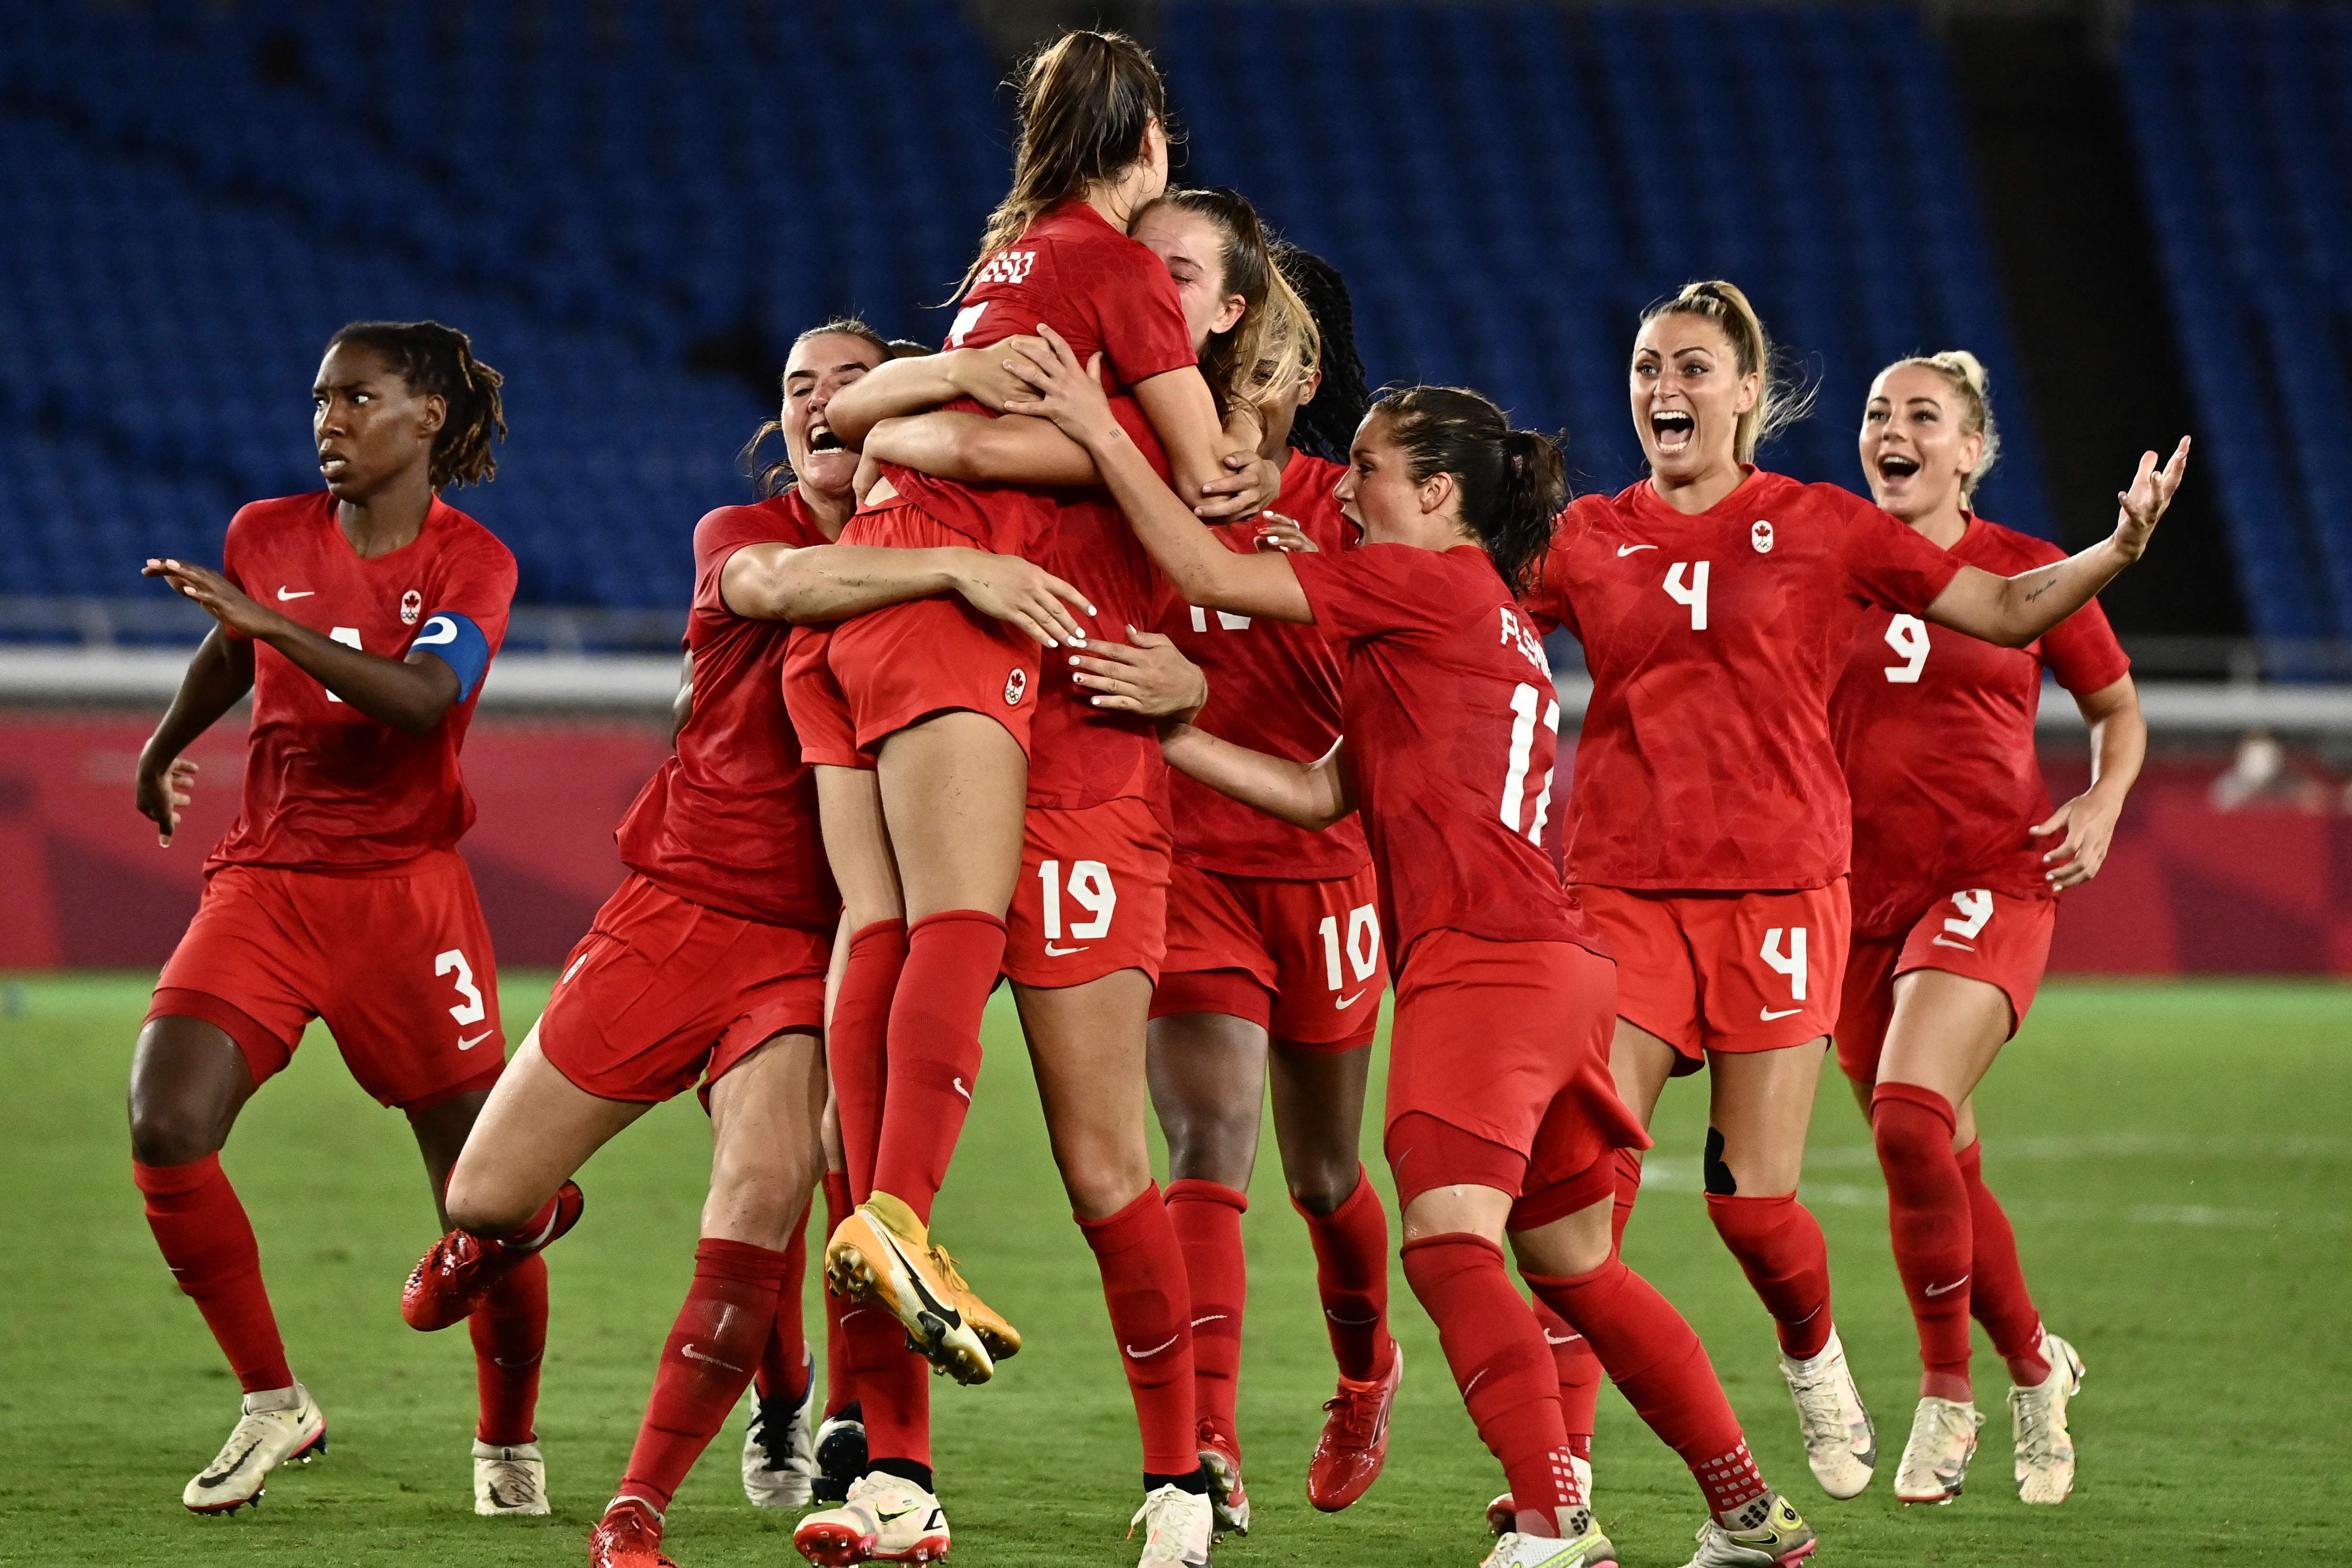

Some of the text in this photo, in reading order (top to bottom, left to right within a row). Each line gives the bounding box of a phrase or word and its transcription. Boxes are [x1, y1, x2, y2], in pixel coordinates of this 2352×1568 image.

[1662, 561, 1710, 630] 4
[1884, 613, 1931, 683] 9
[1038, 860, 1117, 939] 19
[1944, 889, 1994, 940] 9
[1319, 903, 1380, 991] 10
[1759, 927, 1807, 1001] 4
[435, 949, 485, 1025] 3
